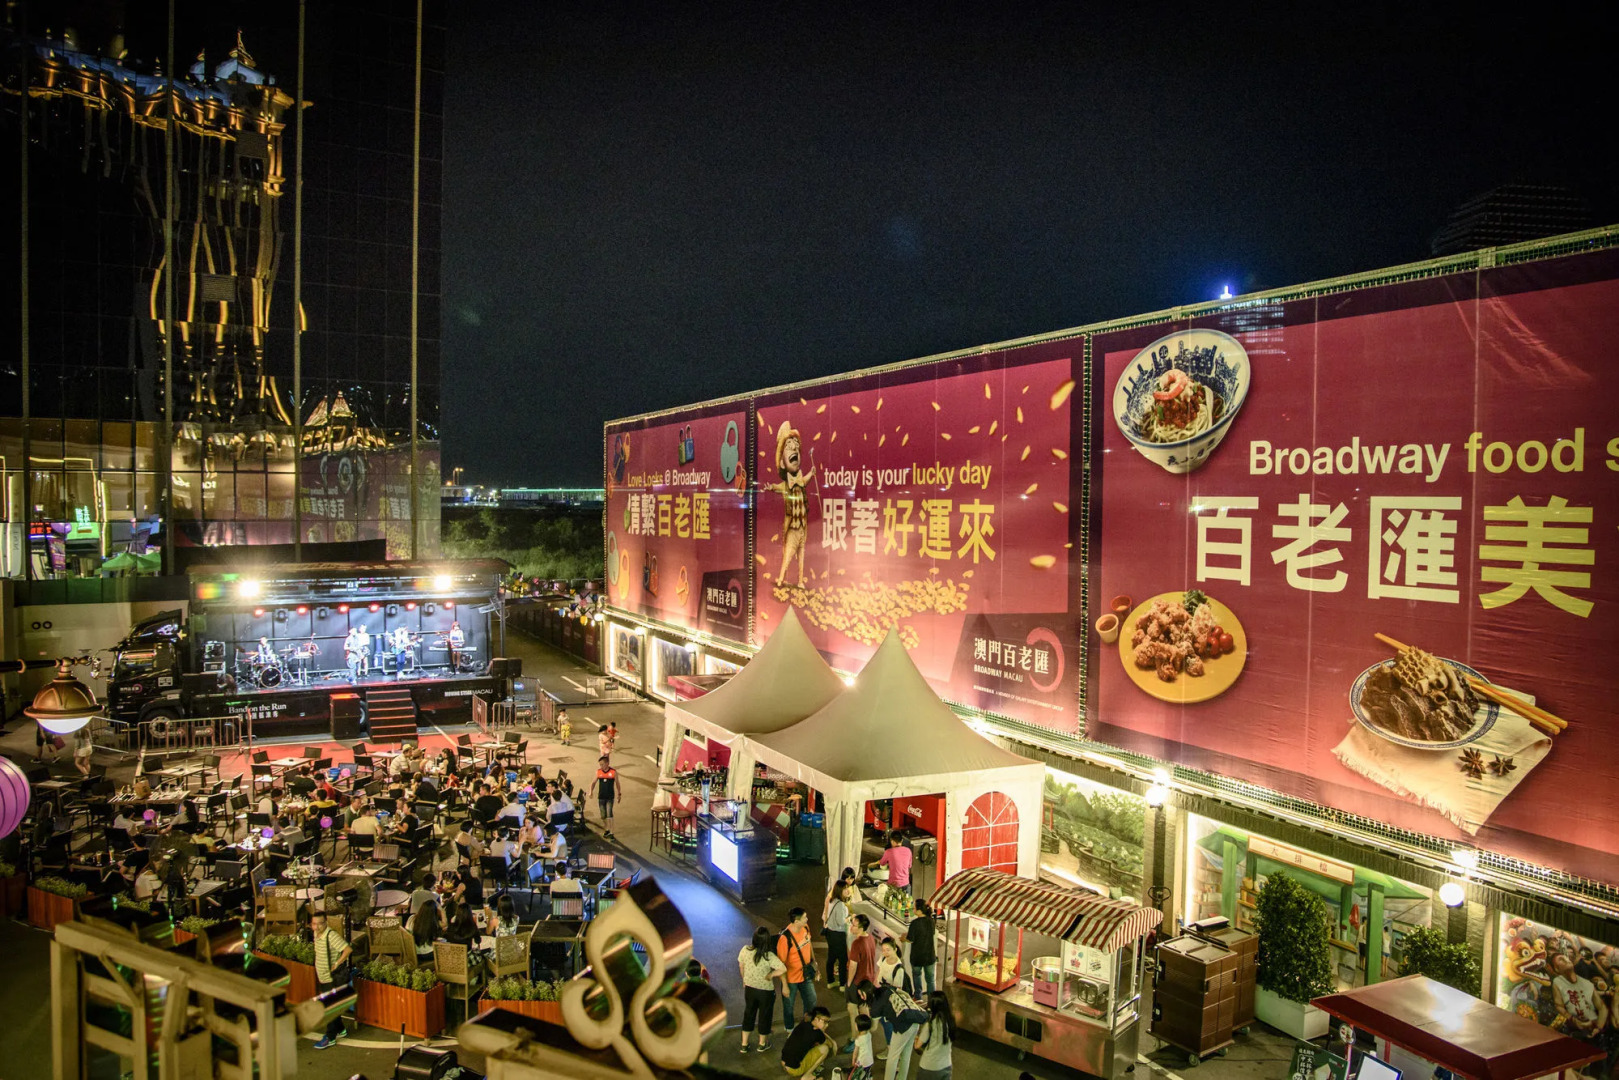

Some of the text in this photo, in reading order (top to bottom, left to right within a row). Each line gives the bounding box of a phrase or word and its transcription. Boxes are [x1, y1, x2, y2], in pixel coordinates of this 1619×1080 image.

[1250, 436, 1451, 482] Broadway
[1464, 428, 1585, 474] food
[672, 468, 711, 488] Broadway
[824, 460, 992, 490] today is your lucky day
[822, 498, 996, 564] 跟著好運來
[974, 637, 1049, 674] 澳門百老匯
[973, 664, 1024, 682] BROADWAY MACAU
[228, 705, 248, 714] Band
[259, 704, 271, 712] the
